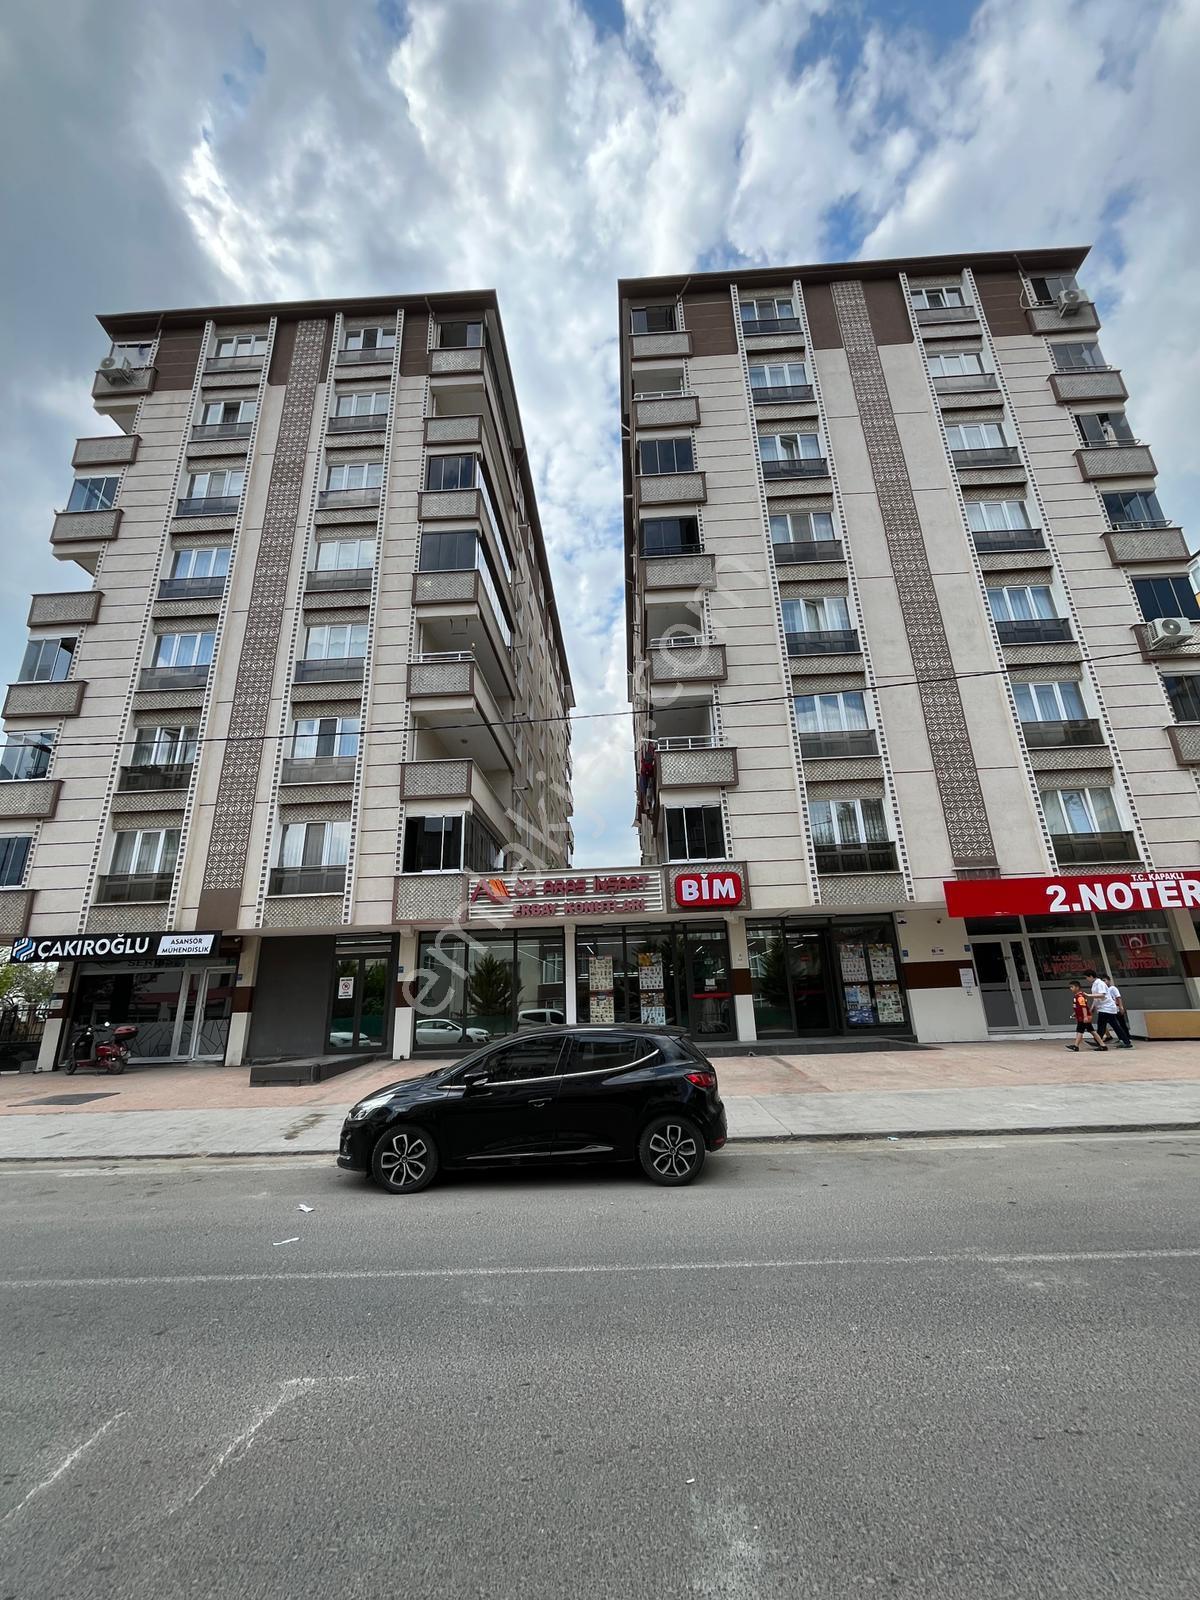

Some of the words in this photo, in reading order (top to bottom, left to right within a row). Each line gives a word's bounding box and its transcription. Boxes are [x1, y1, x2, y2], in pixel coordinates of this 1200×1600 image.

[1131, 874, 1147, 882] T.C.
[1149, 872, 1185, 881] KAPAKLI
[543, 879, 588, 895] ARAS
[682, 874, 736, 901] BİM
[512, 902, 557, 917] ERBAY
[564, 898, 646, 915] KONUTLARI
[37, 934, 149, 960] ÇAKIROĞLU
